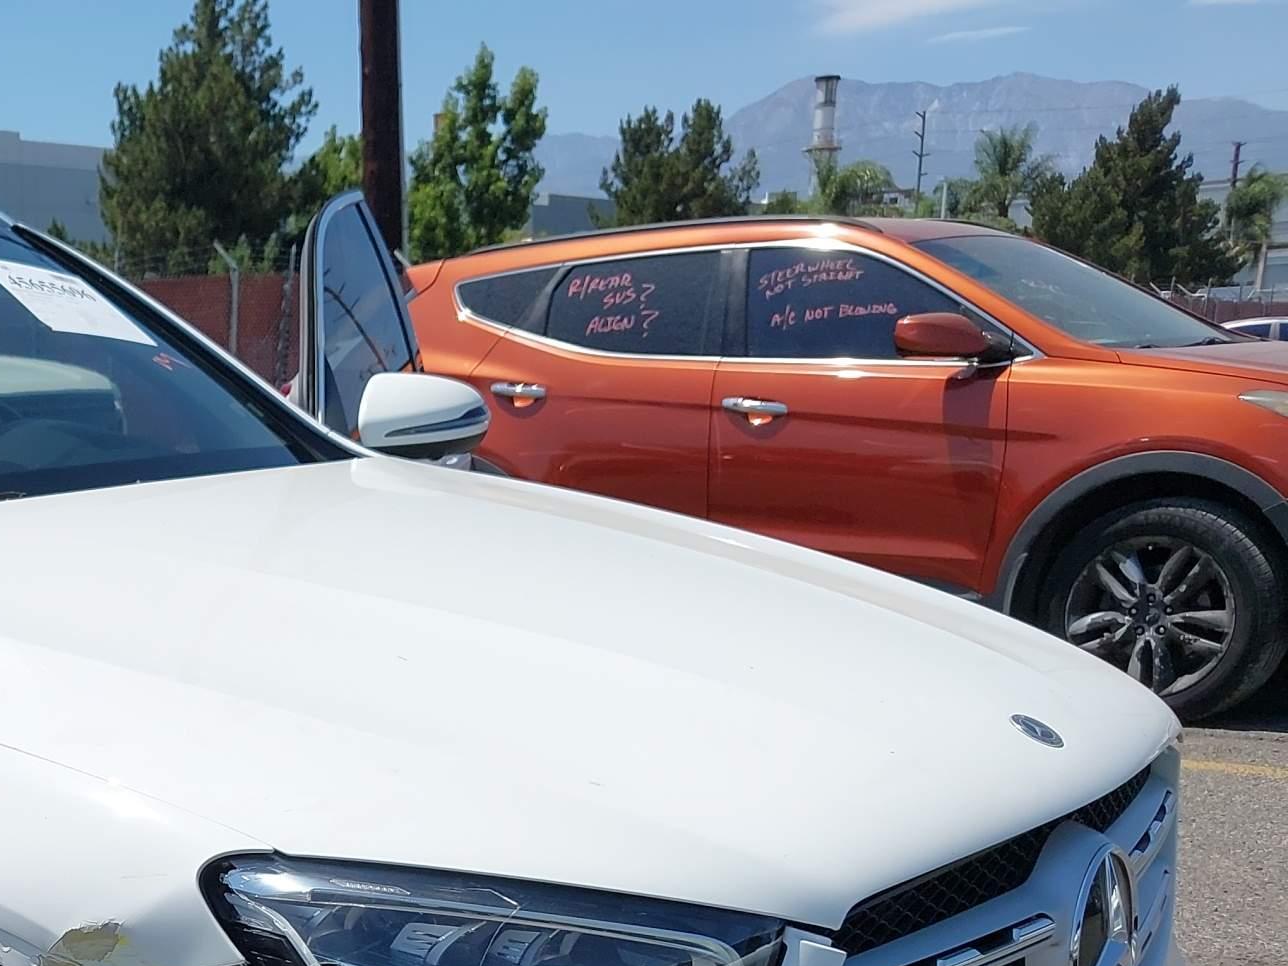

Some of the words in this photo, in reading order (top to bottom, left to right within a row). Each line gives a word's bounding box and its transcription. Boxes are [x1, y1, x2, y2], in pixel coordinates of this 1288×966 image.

[568, 273, 633, 300] R/REAR
[765, 279, 795, 300] NOT
[770, 304, 796, 330] A/C
[804, 306, 834, 323] NOT
